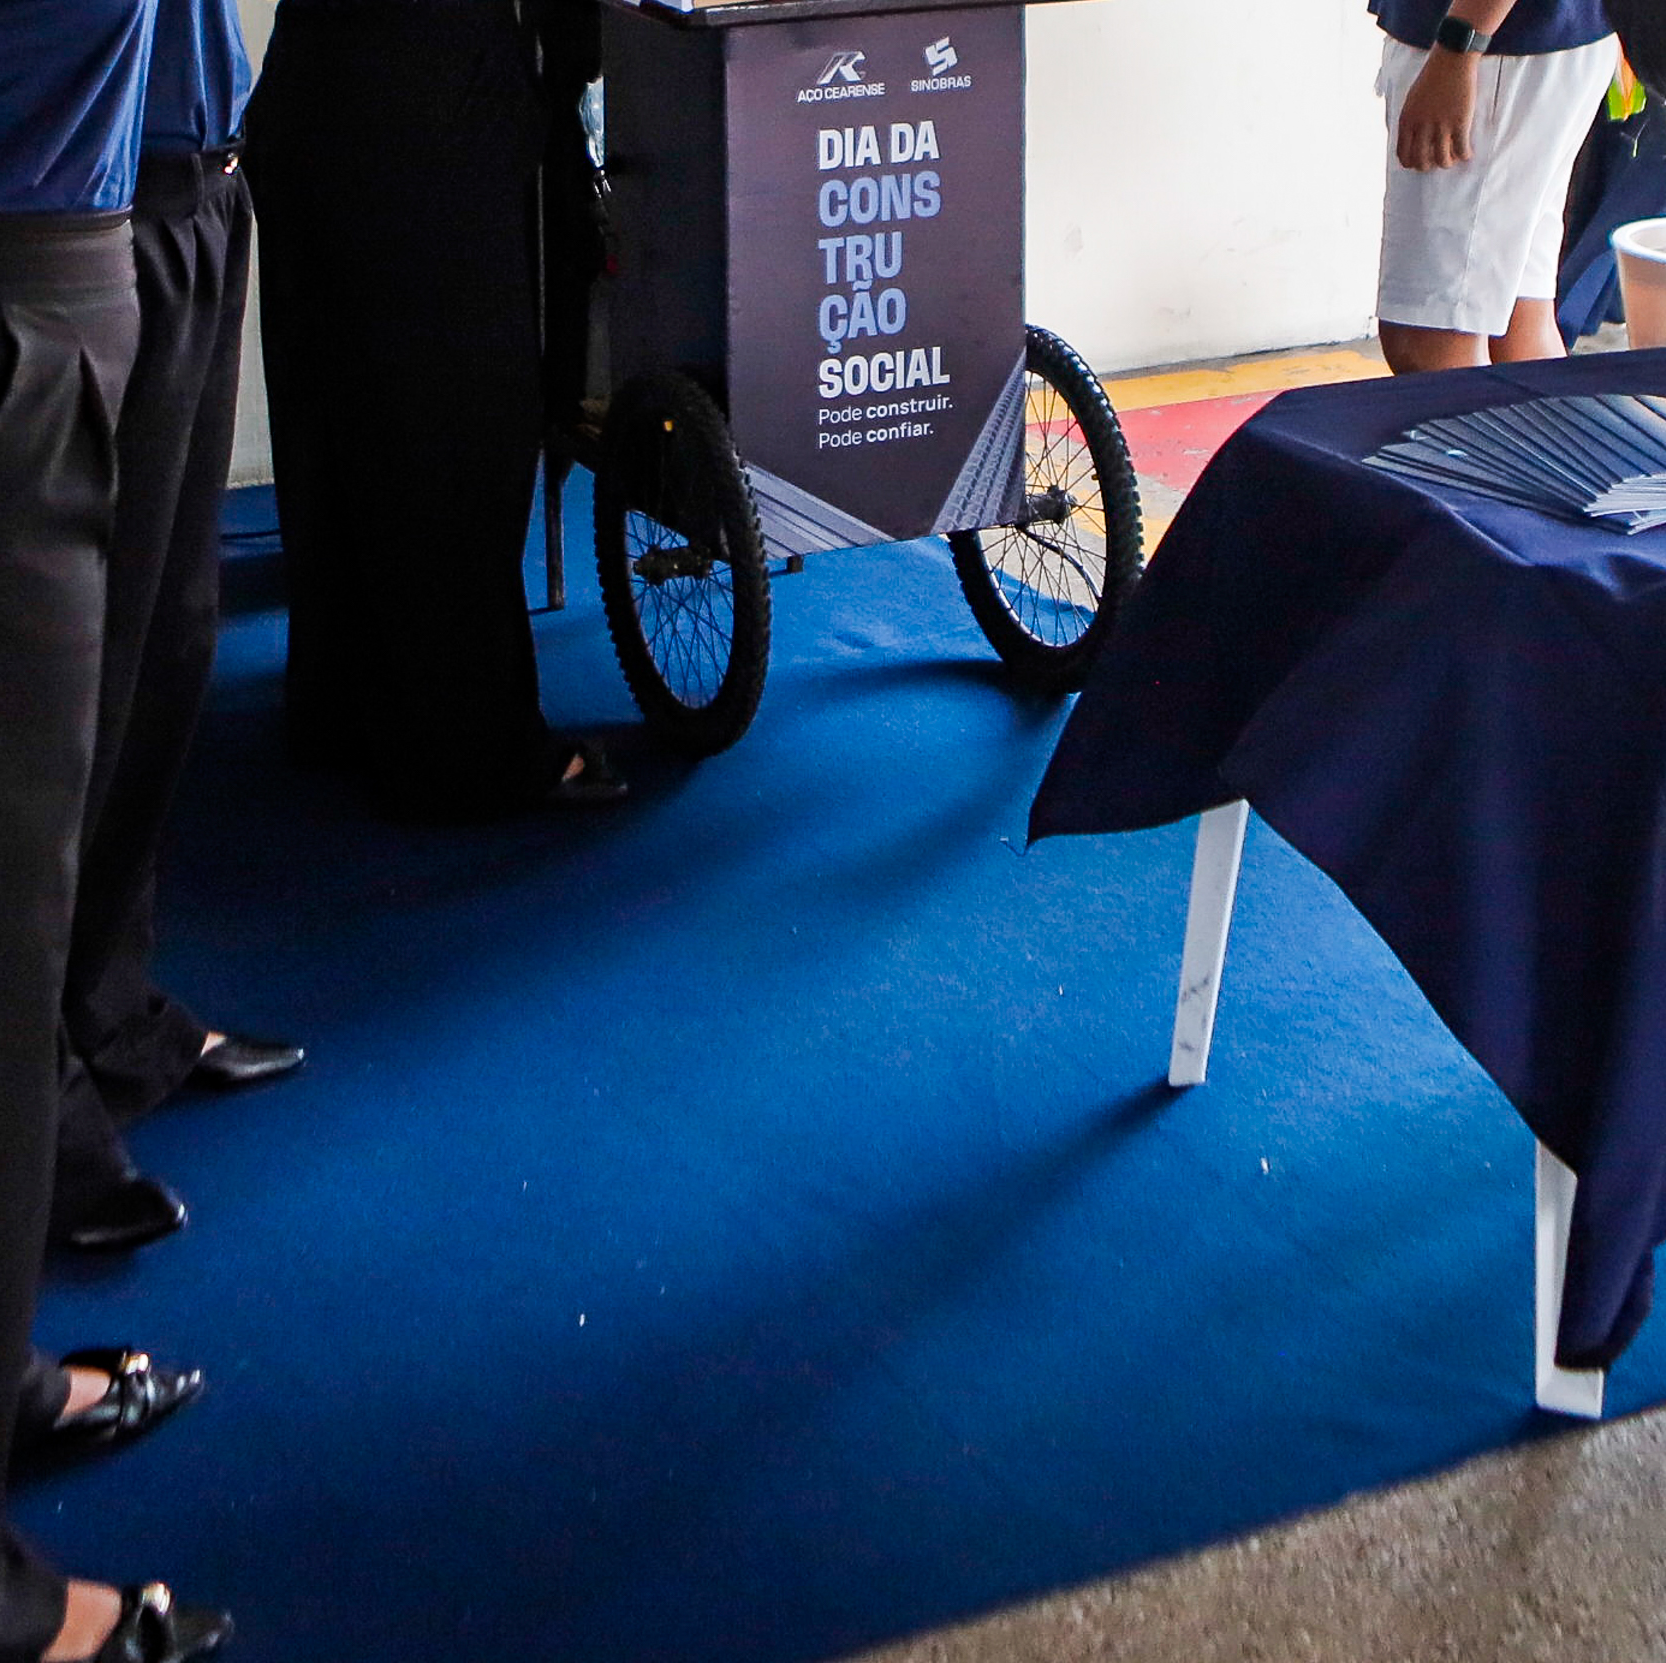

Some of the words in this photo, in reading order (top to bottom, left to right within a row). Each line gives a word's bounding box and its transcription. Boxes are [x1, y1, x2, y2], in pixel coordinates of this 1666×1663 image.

[825, 82, 886, 100] CEARENSE
[910, 75, 972, 93] SINOBRAS
[818, 125, 881, 170] DIA
[890, 120, 940, 164] DA
[818, 170, 942, 228] CONS
[818, 231, 903, 285] TRU
[818, 278, 907, 354] ÇÃO
[818, 345, 951, 399] SOCIAL
[819, 405, 863, 426] Pode
[866, 394, 954, 419] construir.
[819, 430, 863, 450] Pode
[866, 421, 935, 443] confiar.
